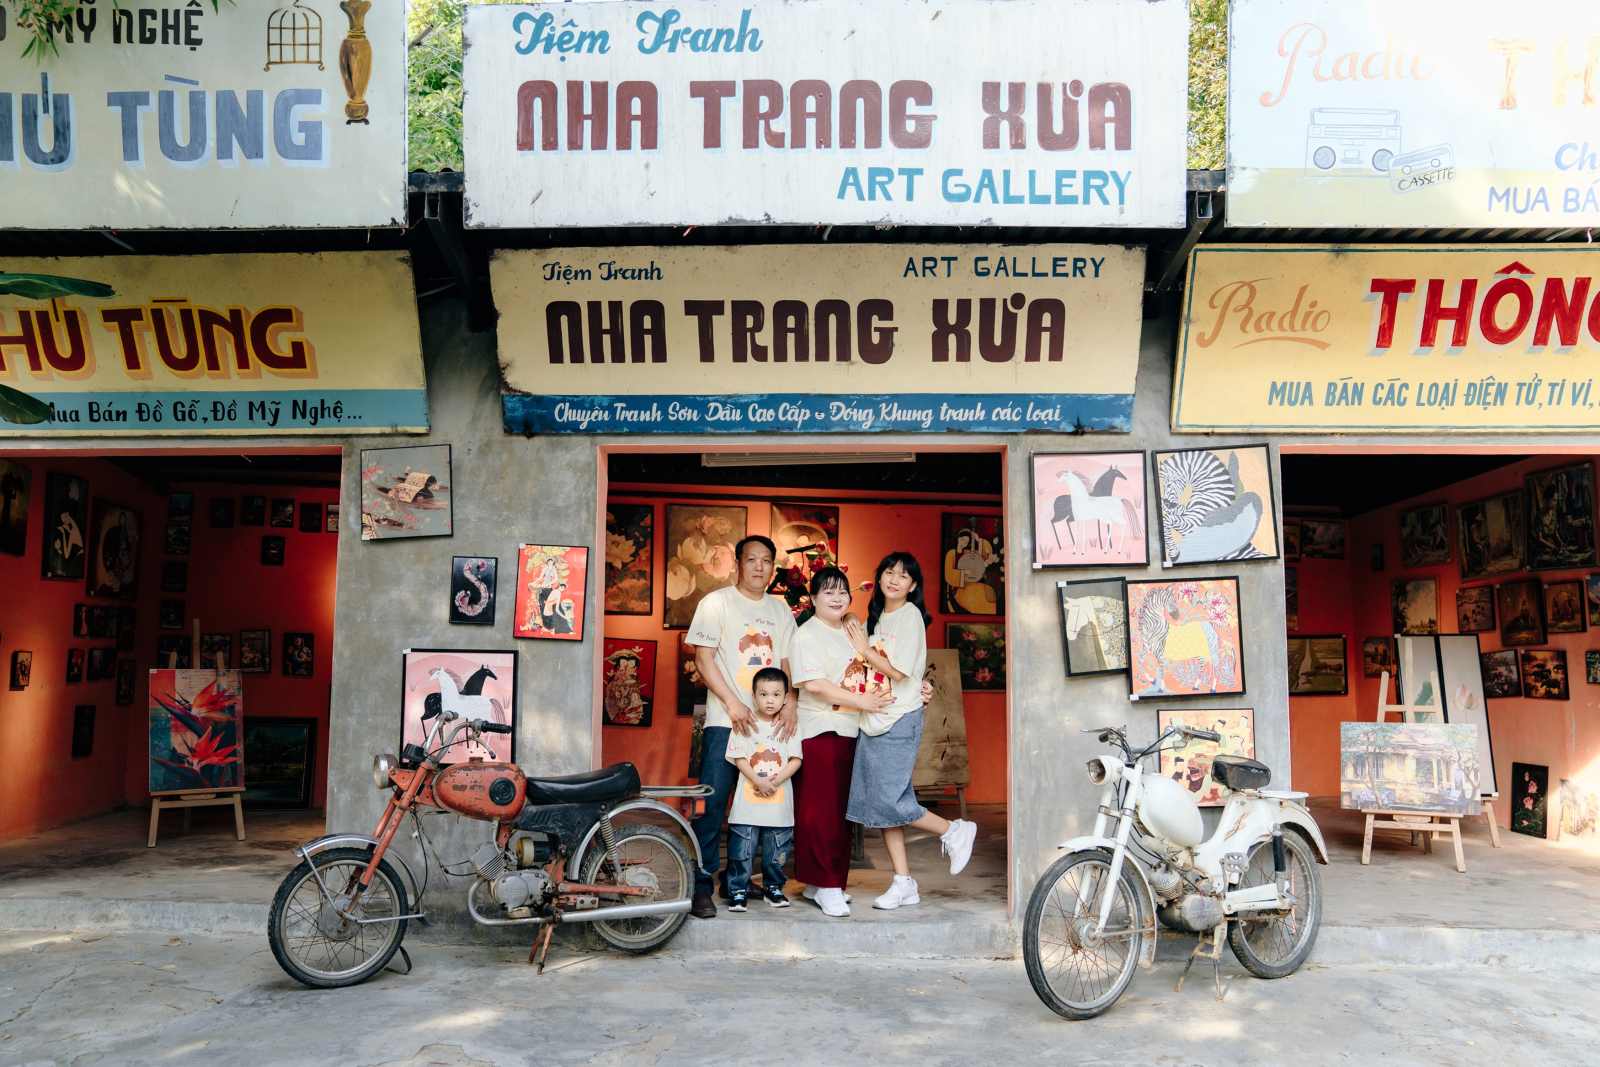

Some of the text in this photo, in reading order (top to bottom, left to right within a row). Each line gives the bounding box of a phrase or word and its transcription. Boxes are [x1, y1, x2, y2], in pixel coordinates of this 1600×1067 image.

[112, 0, 204, 51] NGHỆ
[512, 8, 763, 62] Tiệm Tranh
[1259, 22, 1437, 107] Radio
[516, 79, 1133, 153] NHA TRANG XƯA
[837, 167, 1132, 206] ART GALLERY
[1397, 166, 1456, 192] CASSETTE
[1488, 186, 1550, 214] MUA
[542, 260, 664, 285] Tiệm Tranh
[903, 256, 1106, 278] ART GALLERY
[545, 292, 1066, 365] NHA TRANG XƯA
[1195, 277, 1331, 349] Radio
[1267, 381, 1314, 406] MUA
[1324, 376, 1365, 406] BÁN
[1372, 377, 1410, 407] CÁC
[1416, 378, 1459, 411] LOẠI
[1463, 375, 1509, 411] ĐIỆN
[88, 401, 127, 422] Bán
[135, 400, 163, 422] Đồ
[248, 400, 281, 427] Mỹ
[553, 400, 1064, 430] Chuyên Tranh Sơn Dầu Cao Cấp Đóng Khung tranh các loại
